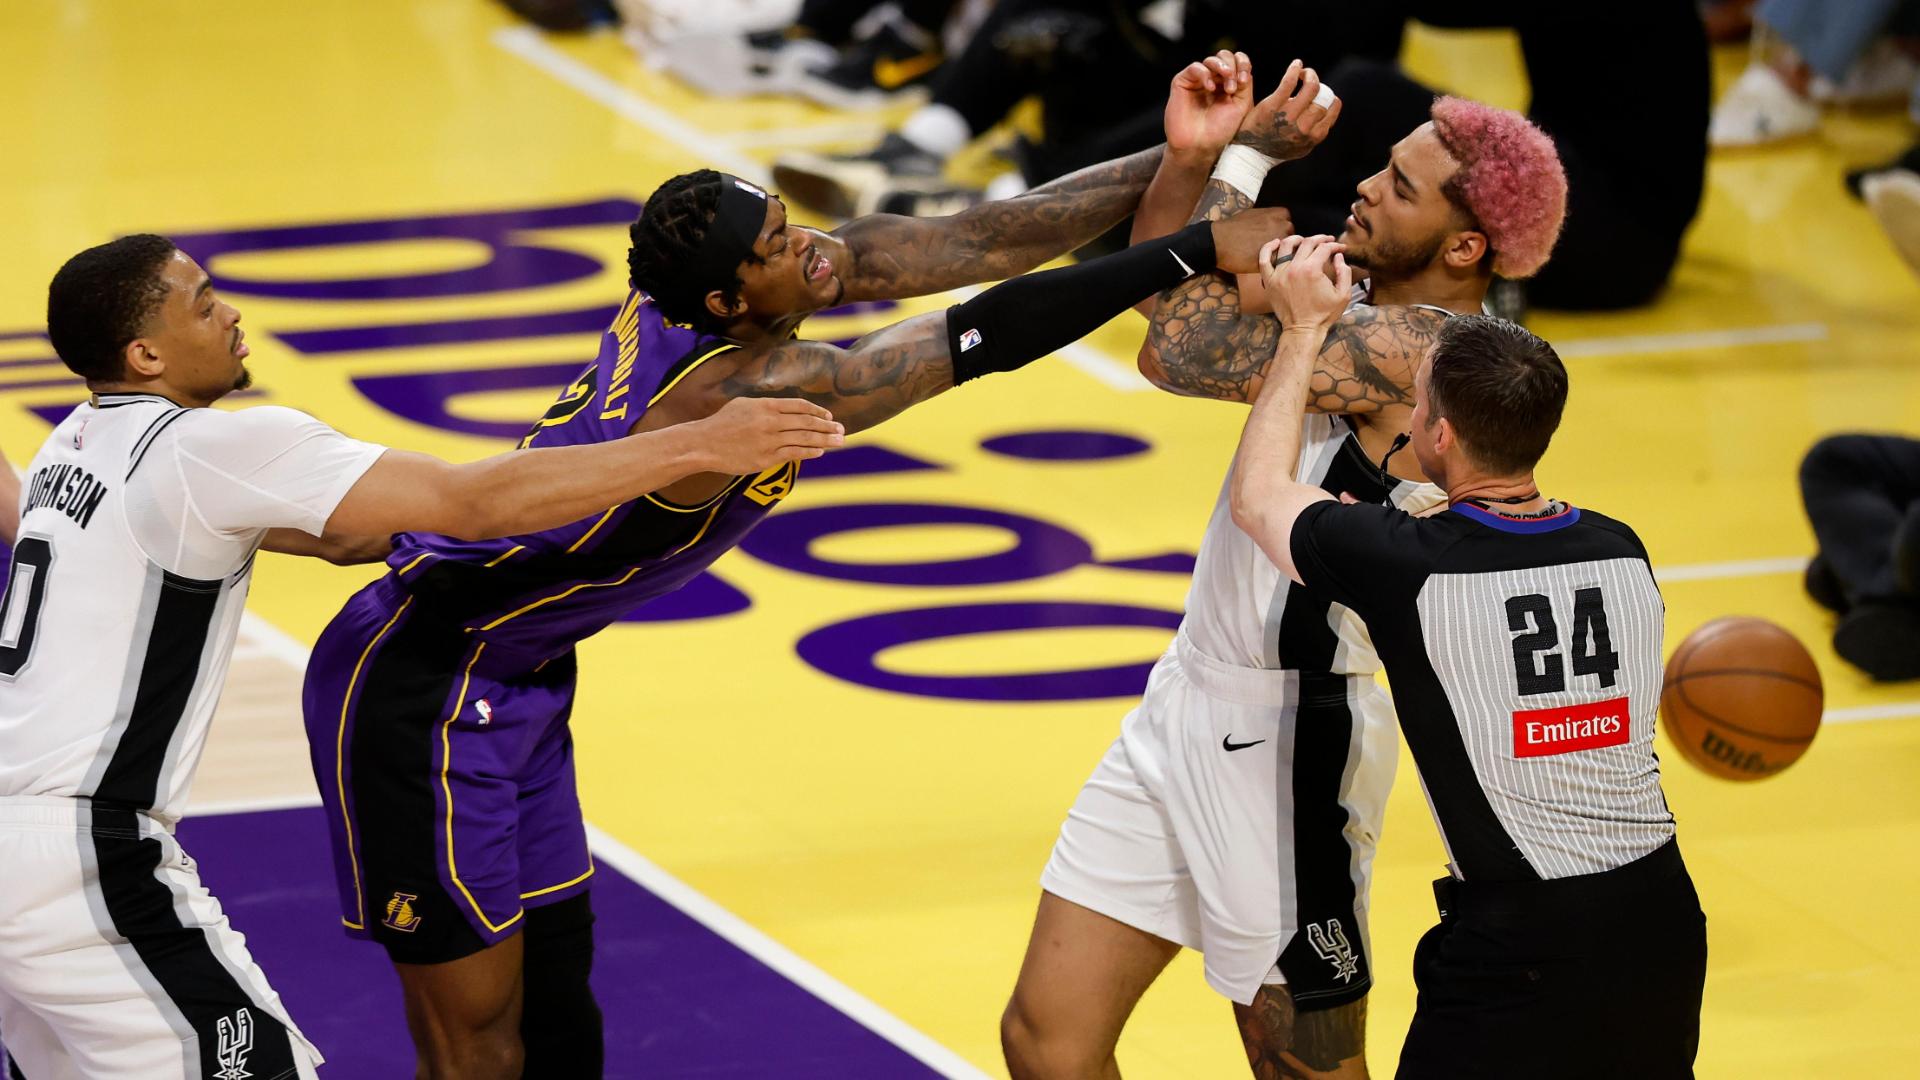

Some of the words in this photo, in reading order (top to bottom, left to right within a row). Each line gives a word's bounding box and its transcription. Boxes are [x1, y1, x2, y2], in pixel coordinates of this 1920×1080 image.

[22, 463, 108, 530] JOHNSON
[0, 532, 57, 682] 0
[1505, 587, 1620, 696] 24
[1526, 714, 1621, 745] Emirates
